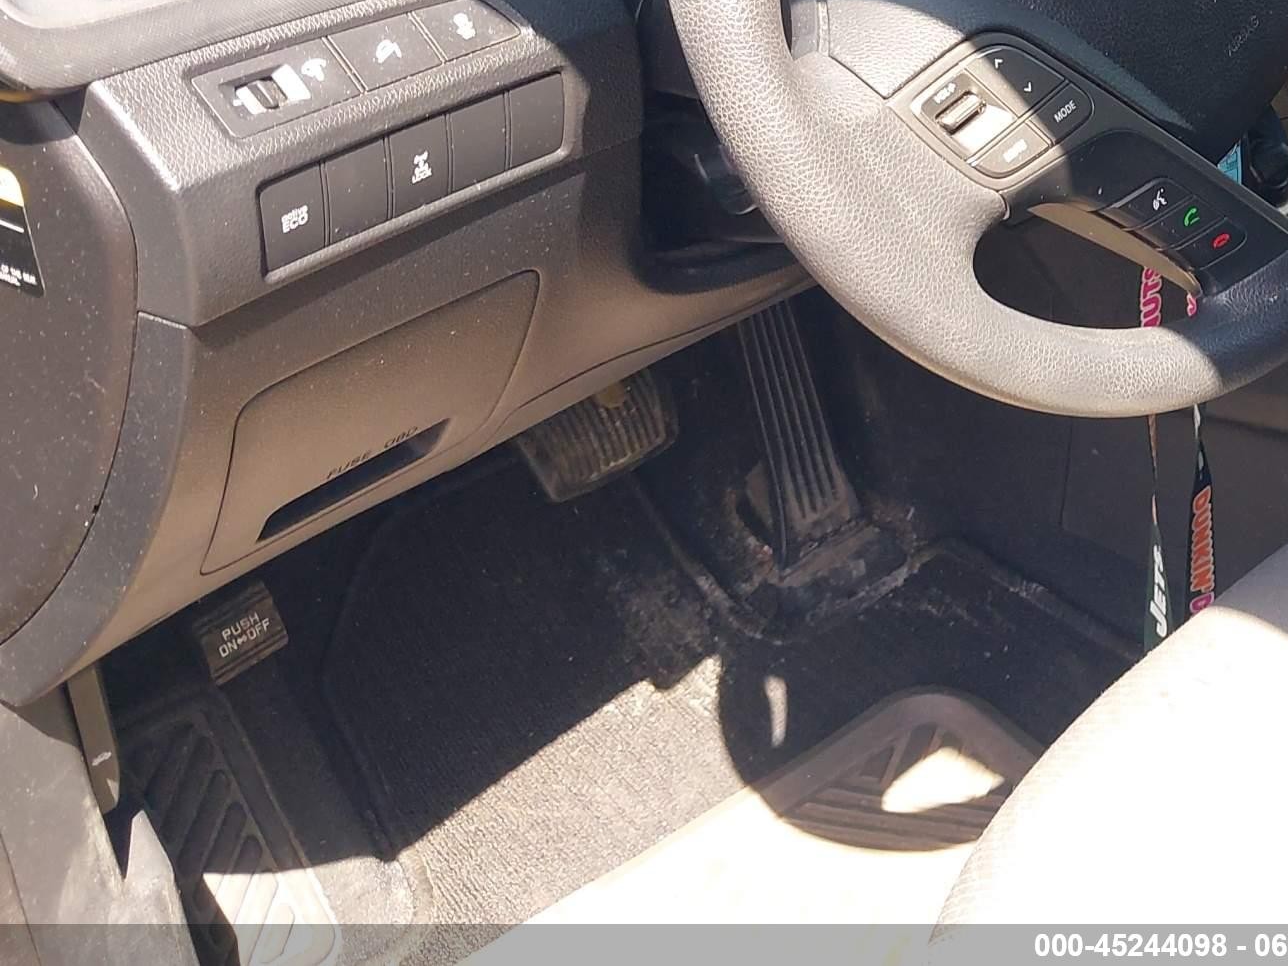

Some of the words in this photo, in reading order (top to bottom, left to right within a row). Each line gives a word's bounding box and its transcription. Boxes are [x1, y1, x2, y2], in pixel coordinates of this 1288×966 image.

[1053, 99, 1077, 123] MODE
[282, 213, 309, 234] ECO
[327, 450, 371, 480] FUSE
[1150, 544, 1168, 638] JETS
[221, 612, 260, 642] PUSH
